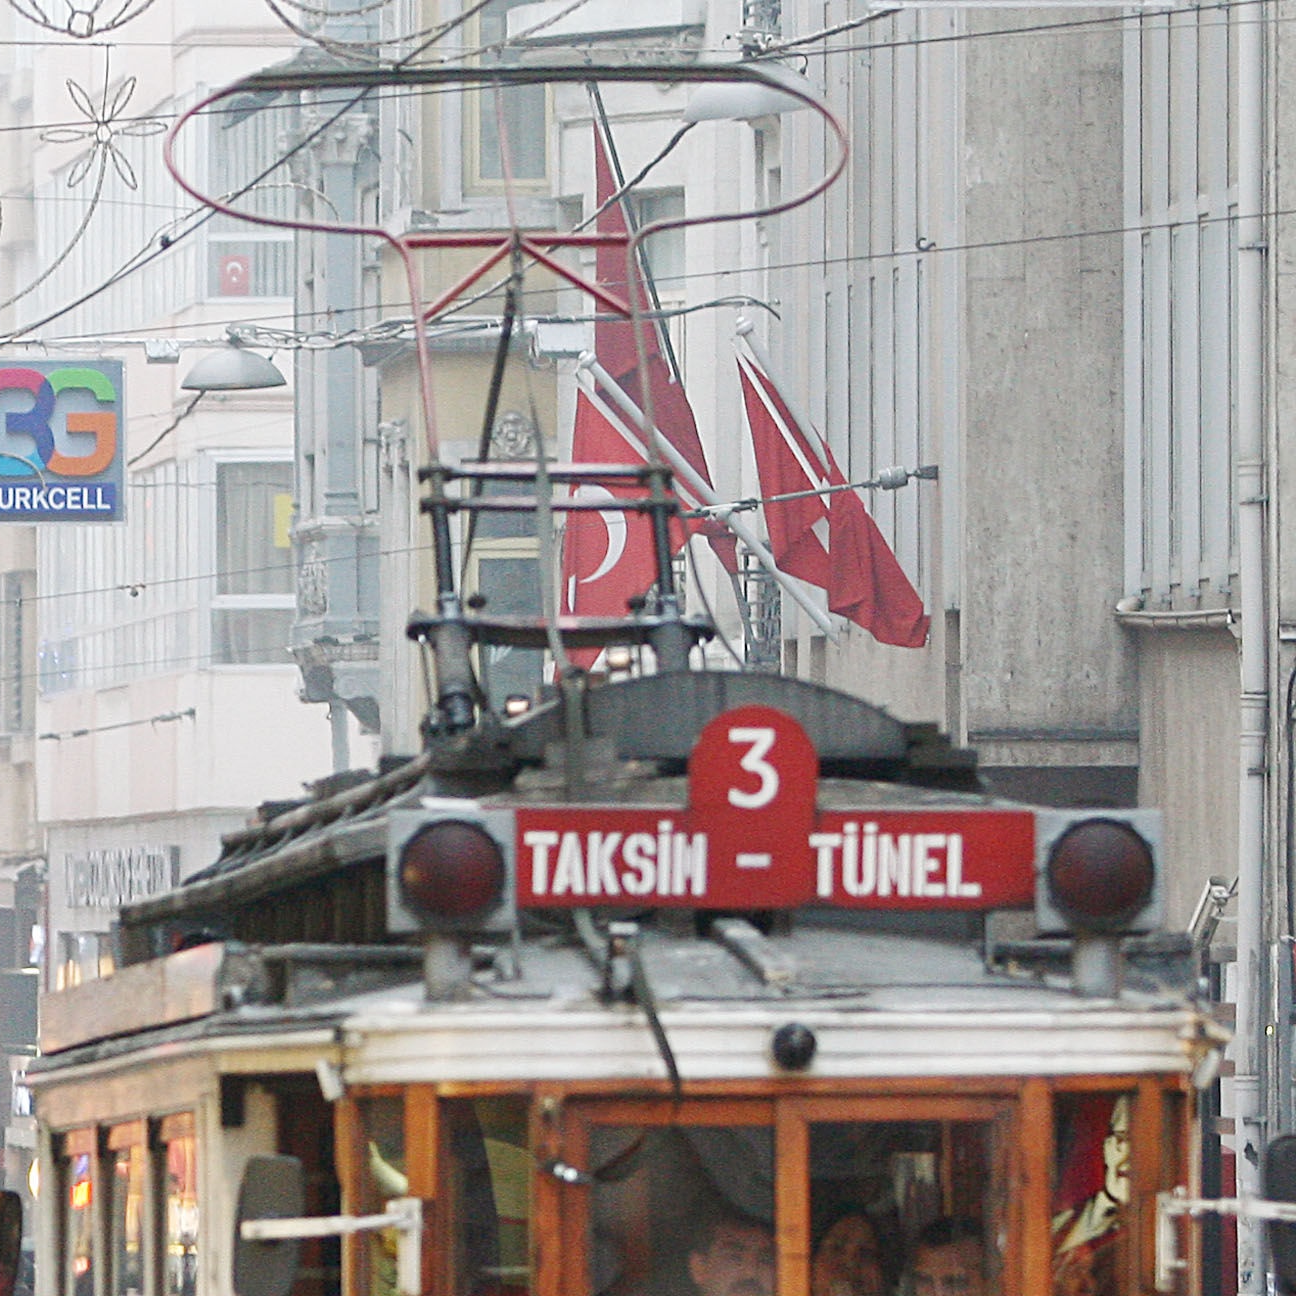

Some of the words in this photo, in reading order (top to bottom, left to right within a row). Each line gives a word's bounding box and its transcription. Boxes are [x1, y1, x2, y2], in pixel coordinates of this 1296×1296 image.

[727, 727, 781, 809] 3
[524, 819, 708, 897] TAKSİM
[810, 822, 982, 898] TÜNEL
